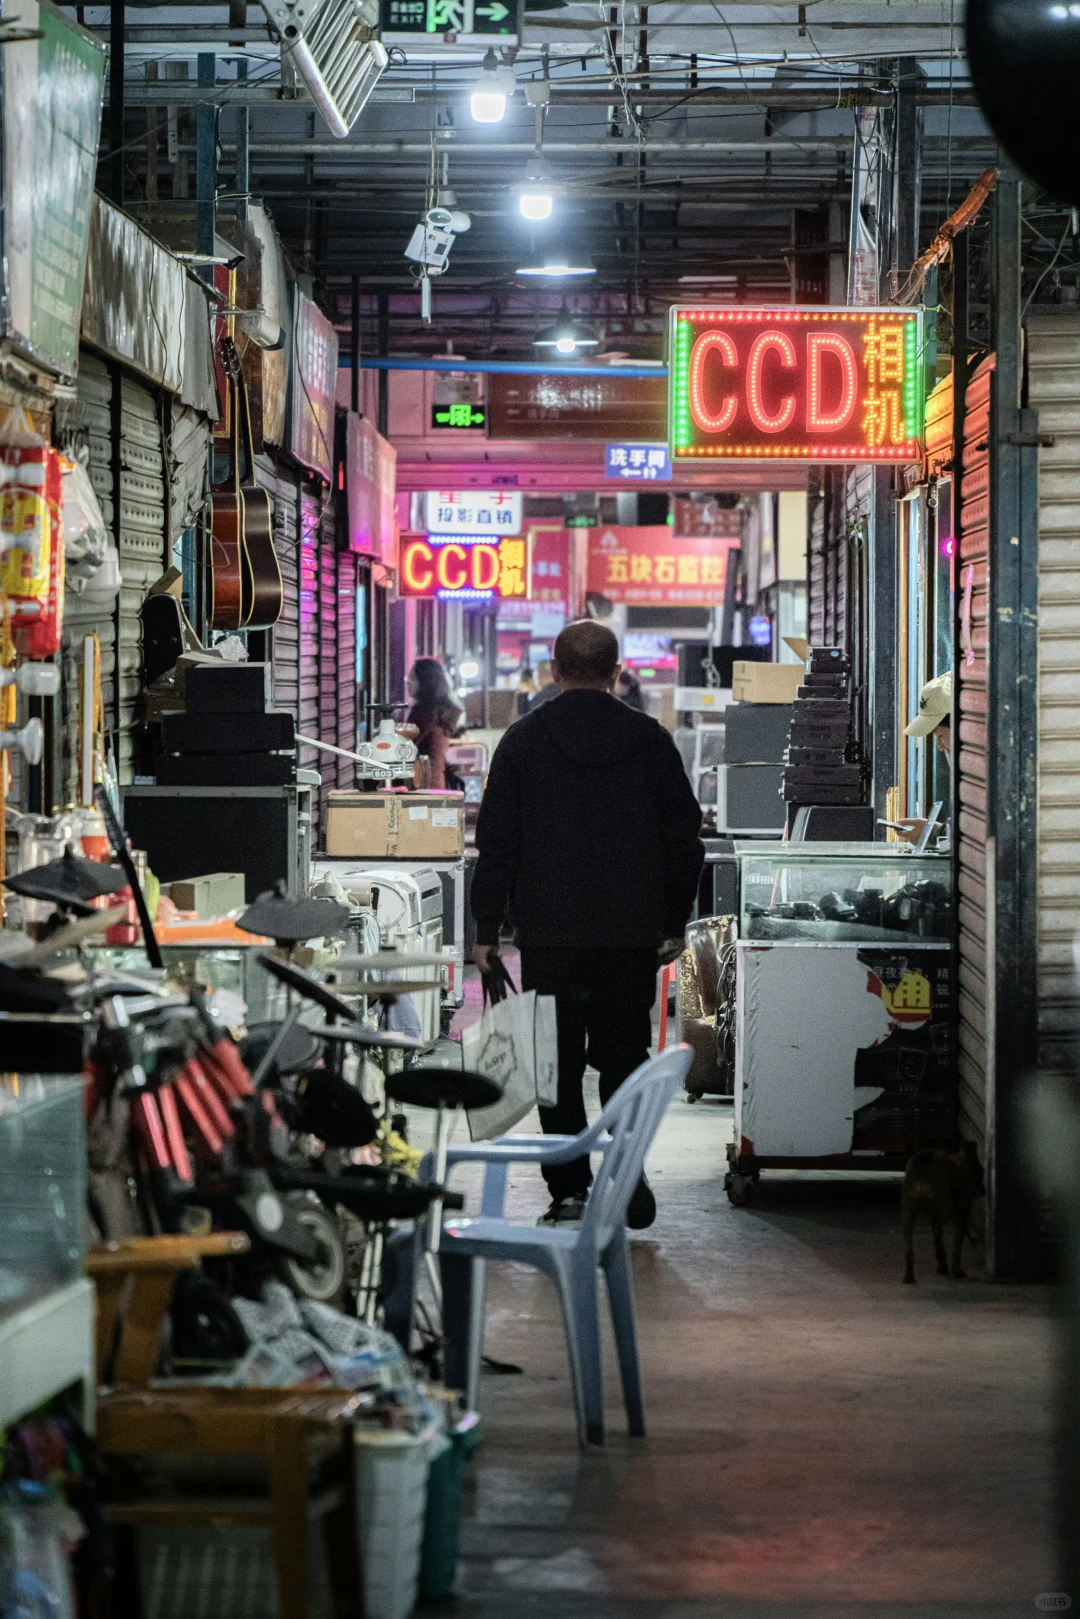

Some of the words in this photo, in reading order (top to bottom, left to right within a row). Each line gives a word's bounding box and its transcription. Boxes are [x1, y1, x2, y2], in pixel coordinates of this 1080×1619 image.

[390, 14, 424, 24] EXIT
[689, 329, 858, 433] CCD
[862, 319, 905, 447] 相机
[610, 448, 666, 468] 洗手间
[437, 508, 512, 524] 投影直销
[404, 541, 500, 591] CCD
[498, 537, 526, 597] 相机
